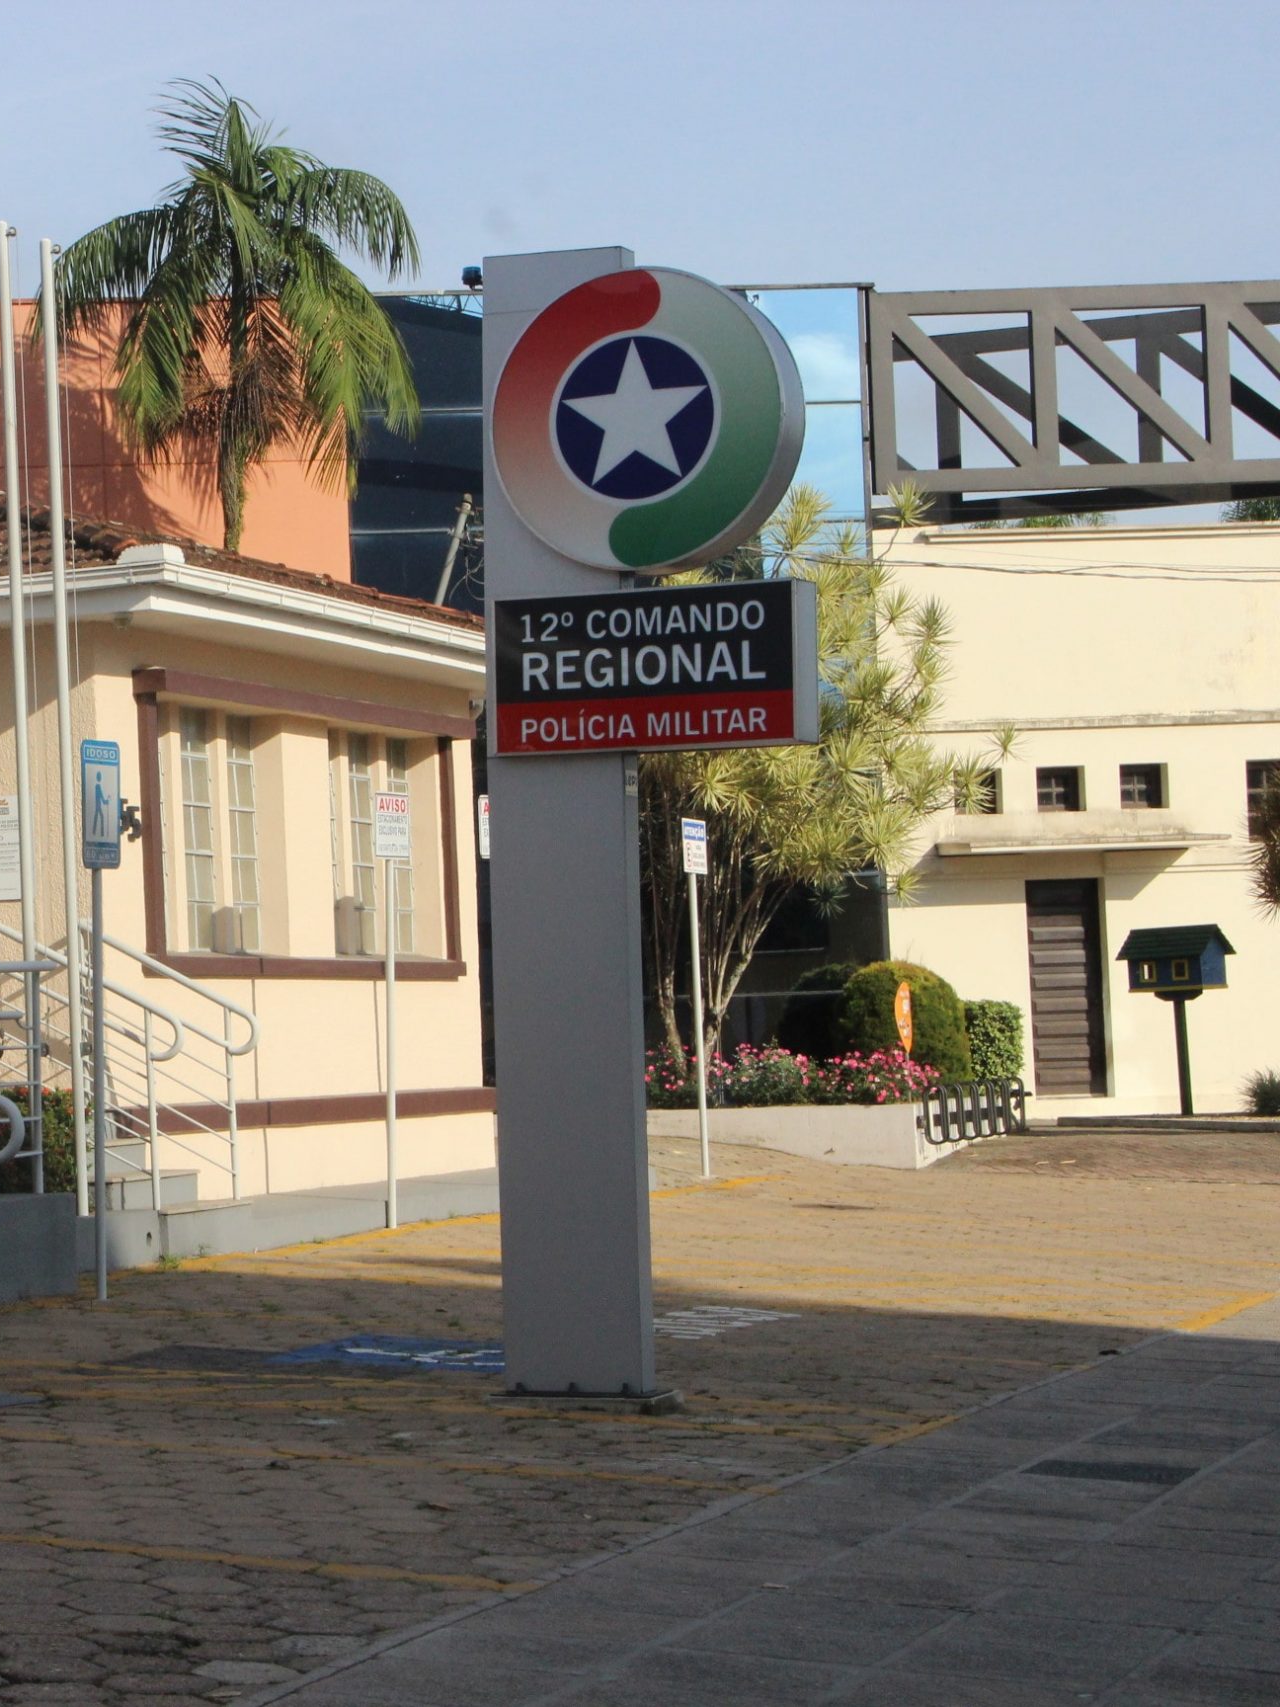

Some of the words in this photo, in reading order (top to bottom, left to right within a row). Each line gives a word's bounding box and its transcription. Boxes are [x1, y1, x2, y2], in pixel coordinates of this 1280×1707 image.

[585, 600, 766, 640] COMANDO
[521, 640, 767, 692] REGIONAL
[520, 708, 636, 744] POLÍCIA
[647, 706, 768, 737] MILITAR
[86, 747, 117, 760] IDOSO
[379, 797, 407, 813] AVISO
